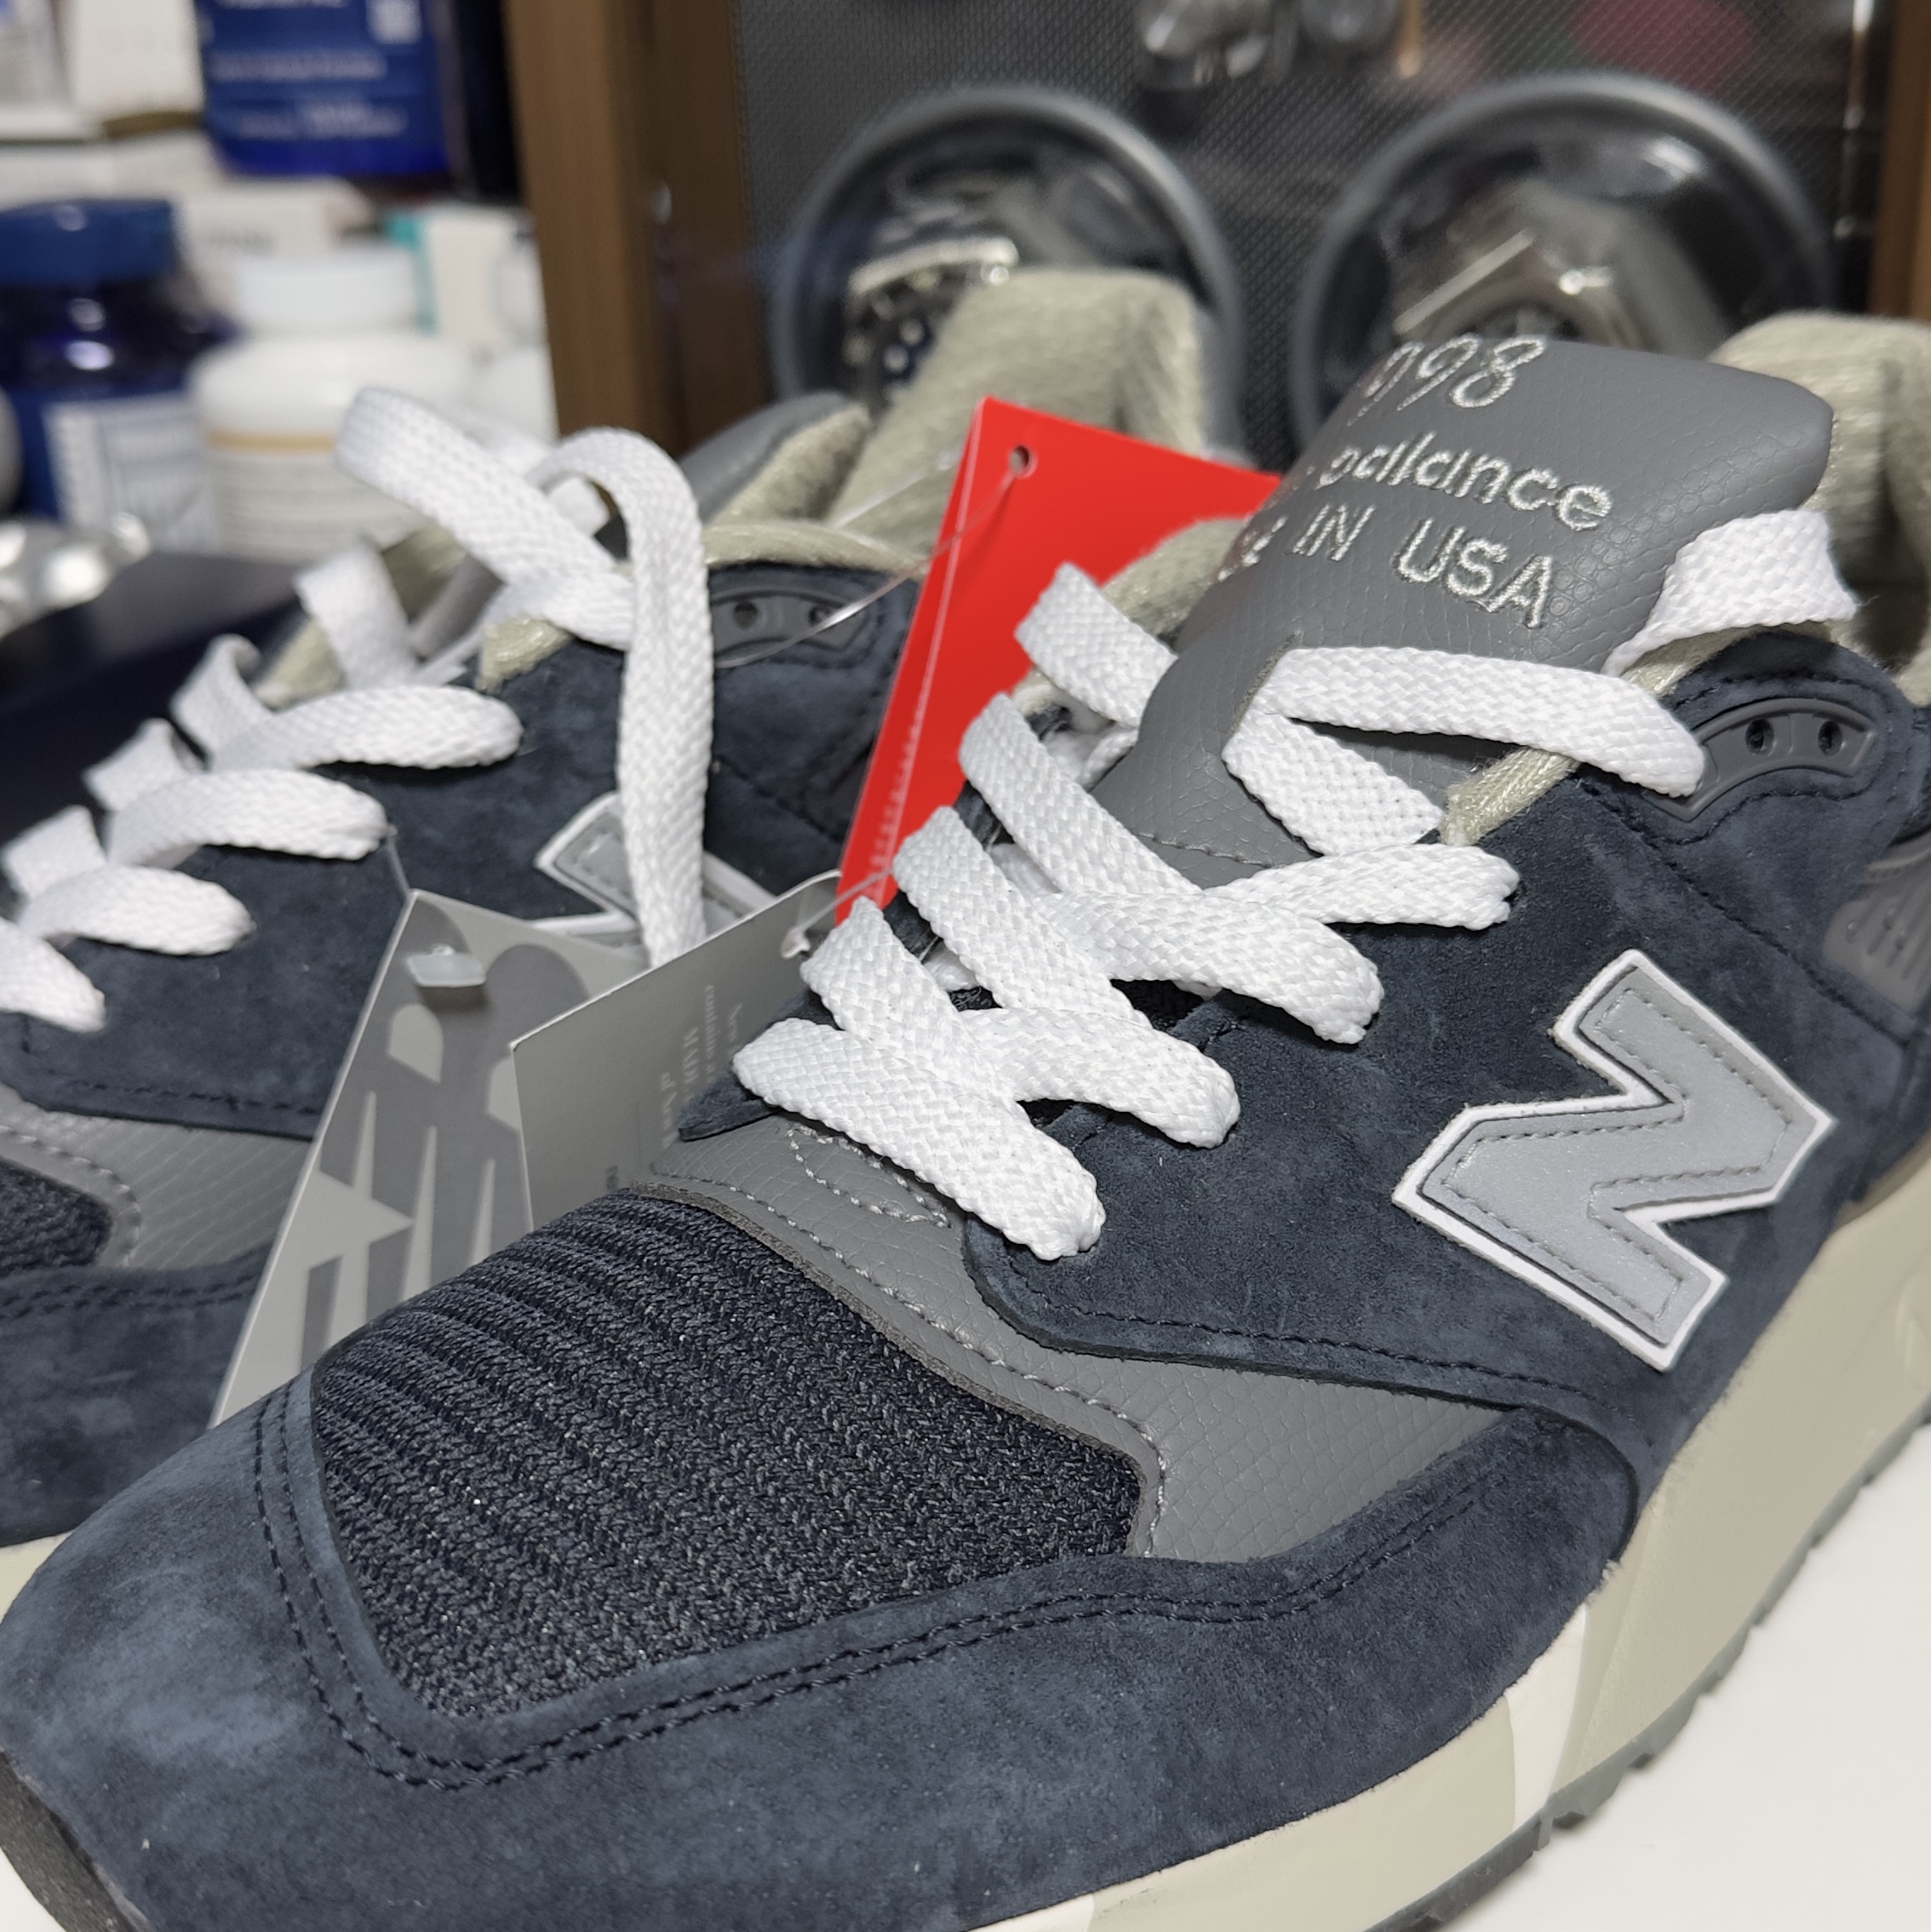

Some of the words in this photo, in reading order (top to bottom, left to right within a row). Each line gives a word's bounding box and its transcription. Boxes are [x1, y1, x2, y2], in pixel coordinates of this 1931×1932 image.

[1292, 502, 1377, 561] IN
[1395, 516, 1554, 628] USA
[1392, 948, 1838, 1373] N
